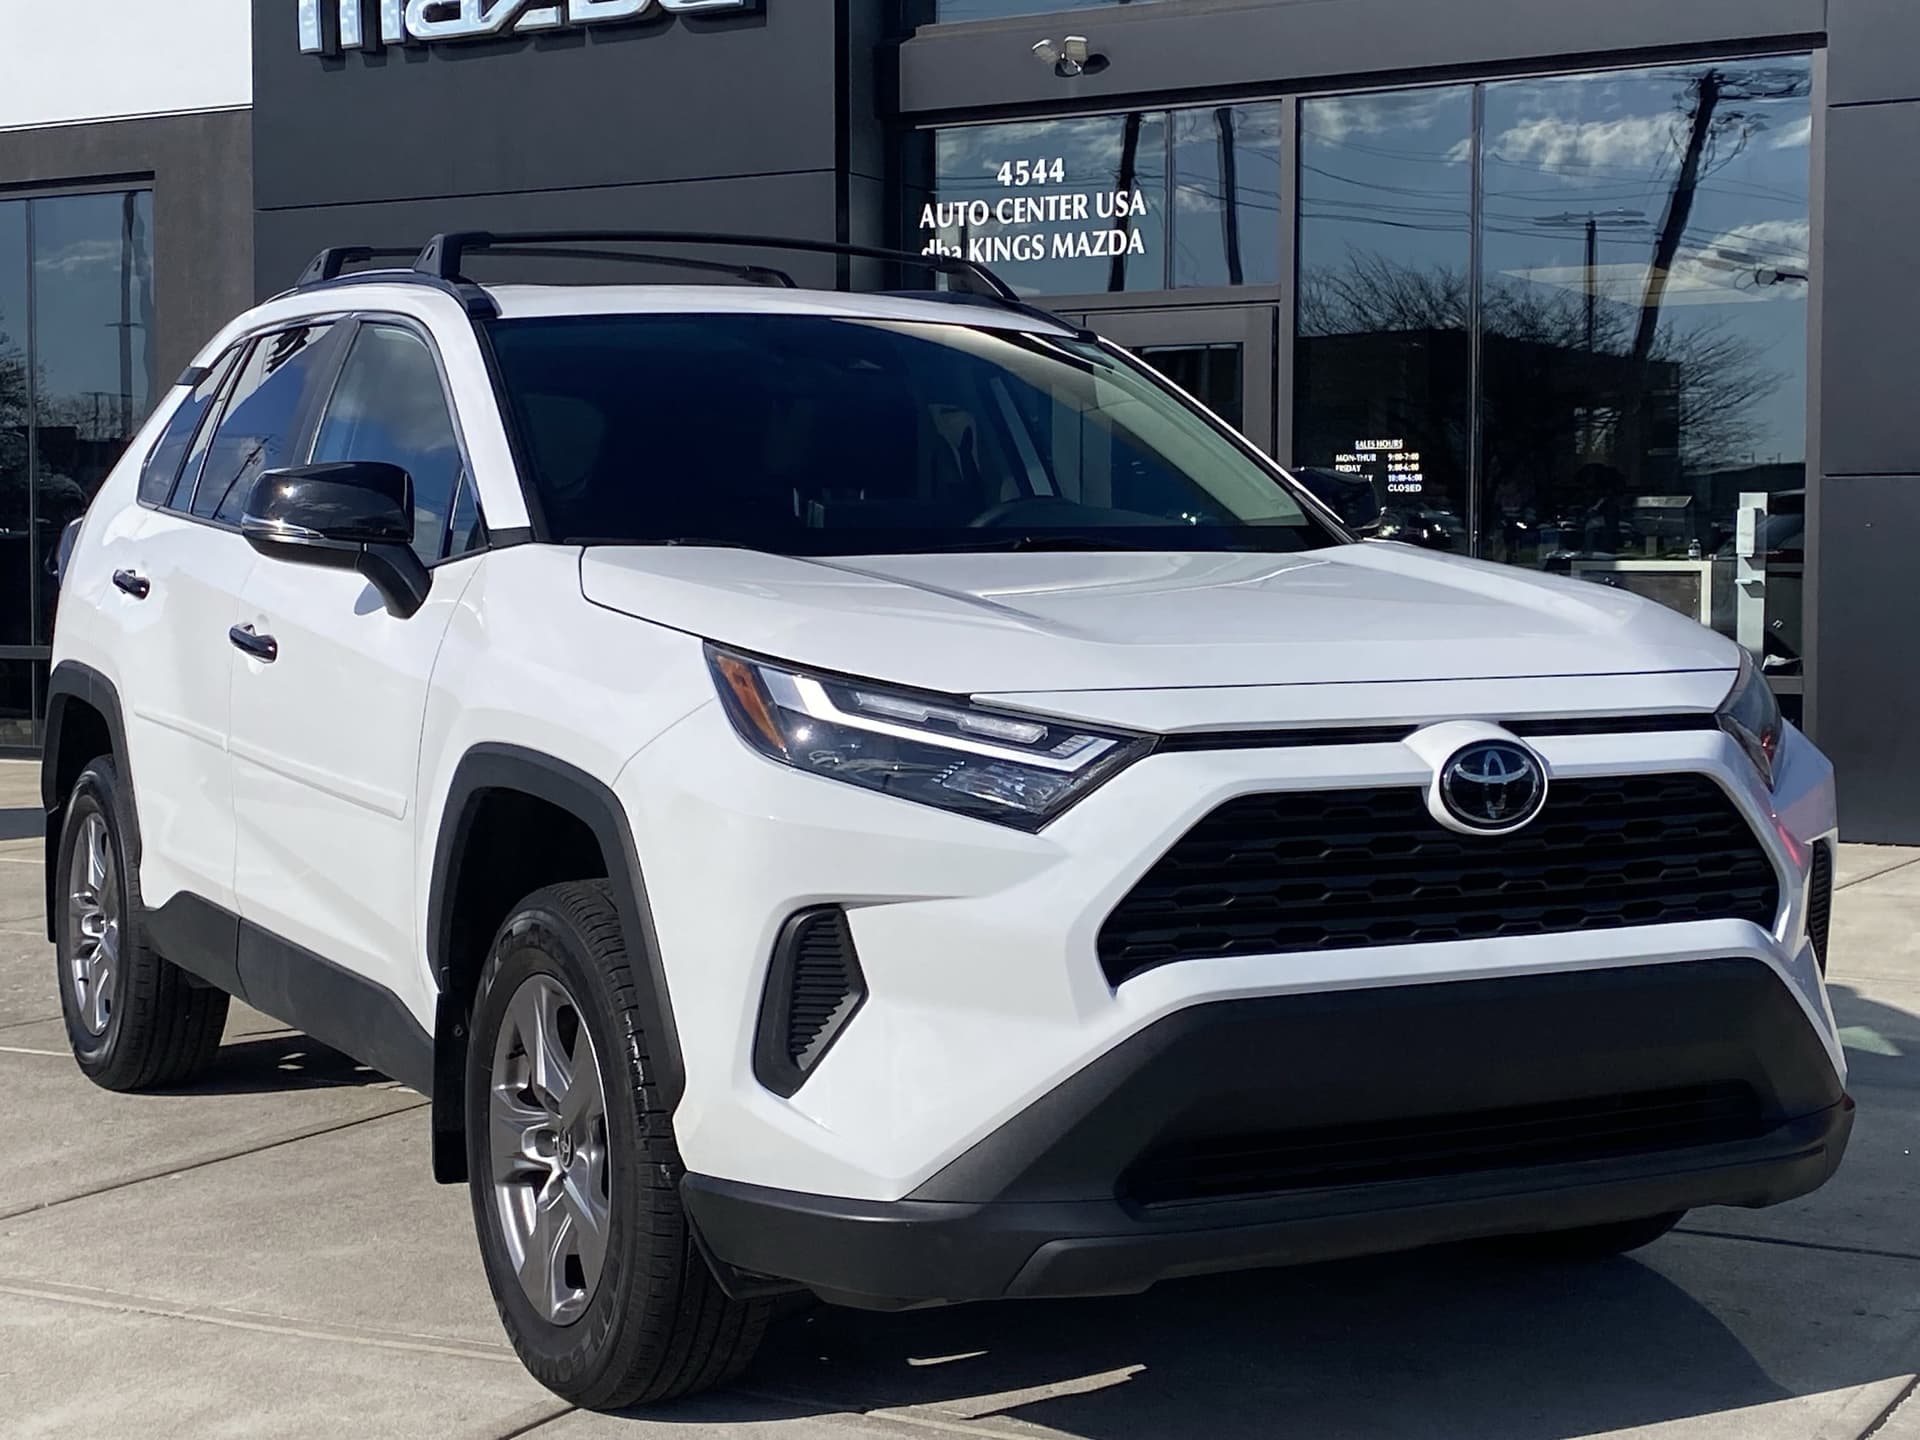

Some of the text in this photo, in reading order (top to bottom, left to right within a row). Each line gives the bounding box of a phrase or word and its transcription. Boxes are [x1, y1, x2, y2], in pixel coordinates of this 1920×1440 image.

[996, 157, 1066, 187] 4544
[919, 189, 1148, 230] AUTO CENTER USA
[968, 233, 1046, 264] KINGS
[1051, 227, 1146, 260] MAZDA
[1355, 438, 1403, 449] SALES HOURS
[1335, 464, 1361, 472] FRIDAY
[1387, 483, 1422, 492] CLOSED
